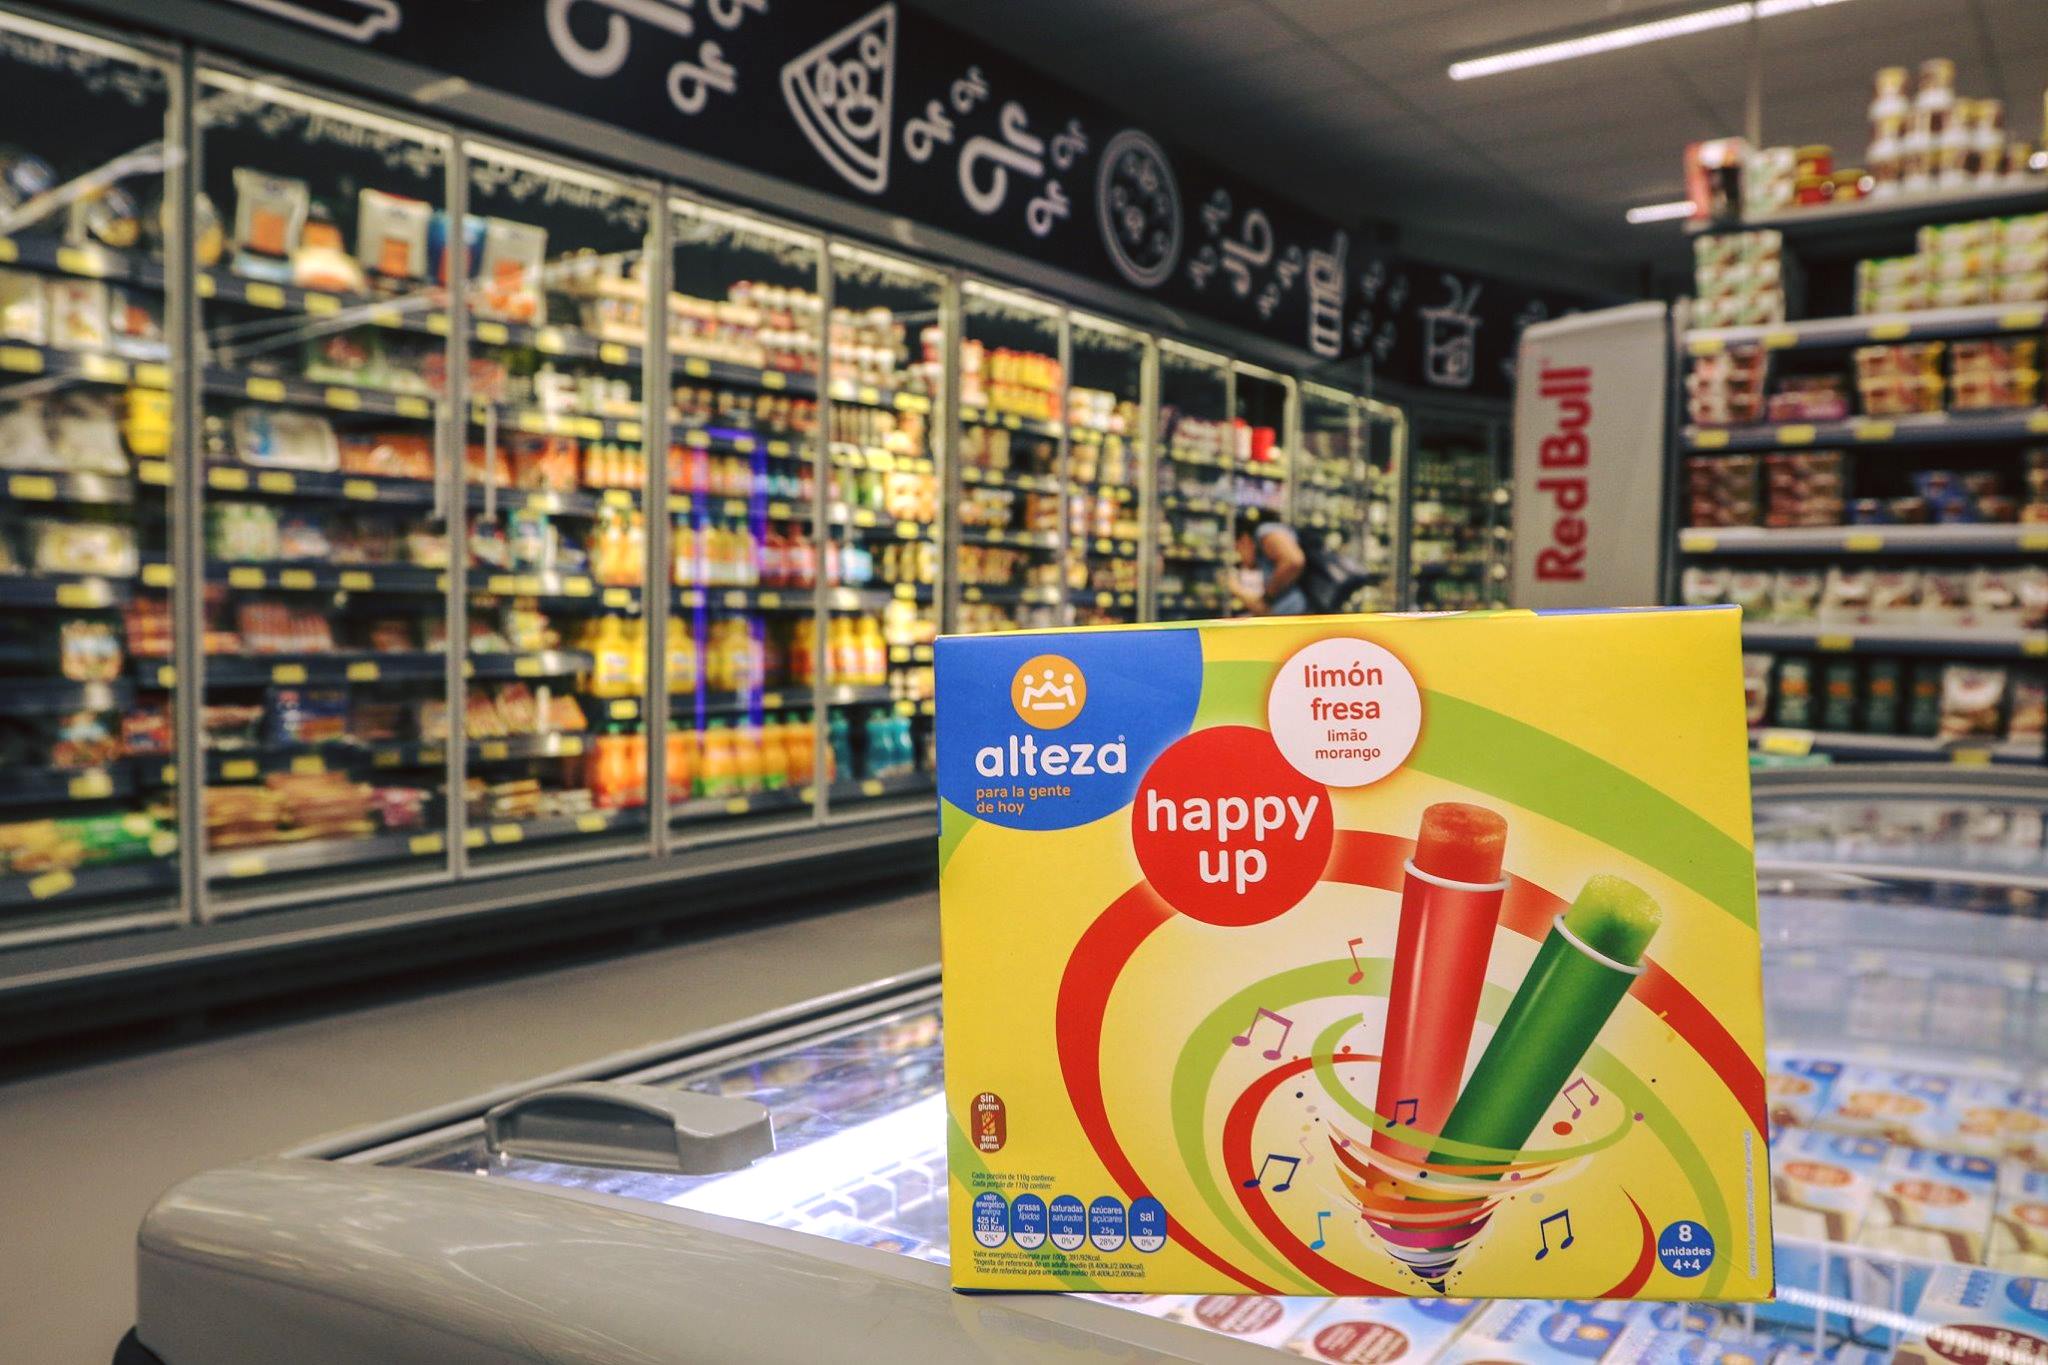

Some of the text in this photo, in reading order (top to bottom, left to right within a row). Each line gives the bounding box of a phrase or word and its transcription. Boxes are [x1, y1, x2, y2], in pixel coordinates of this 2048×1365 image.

[1535, 367, 1592, 580] Red Bull
[1304, 661, 1383, 687] limón
[1310, 697, 1381, 721] fresa
[1327, 729, 1368, 742] limão
[975, 735, 1127, 777] alteza
[1315, 746, 1381, 761] morango
[976, 785, 1070, 800] para la gente
[976, 800, 1025, 815] de hoy
[1147, 790, 1319, 841] happy
[1199, 848, 1267, 894] up
[980, 1093, 994, 1102] sin
[978, 1103, 999, 1111] gluten
[976, 1201, 1005, 1210] energético
[1018, 1204, 1040, 1212] grasas
[1051, 1205, 1083, 1213] saturadas
[1091, 1206, 1122, 1214] azúcares
[1052, 1214, 1083, 1222] saturados
[1093, 1214, 1122, 1223] açúcares
[1140, 1211, 1154, 1221] sal
[977, 1224, 990, 1232] 100
[1025, 1225, 1033, 1233] 0g
[1064, 1226, 1072, 1234] 0g
[1101, 1227, 1114, 1235] 25g
[1143, 1227, 1152, 1236] 0g
[1679, 1225, 1692, 1242] 8
[1661, 1247, 1711, 1256] unidades
[1673, 1259, 1701, 1271] 4+4
